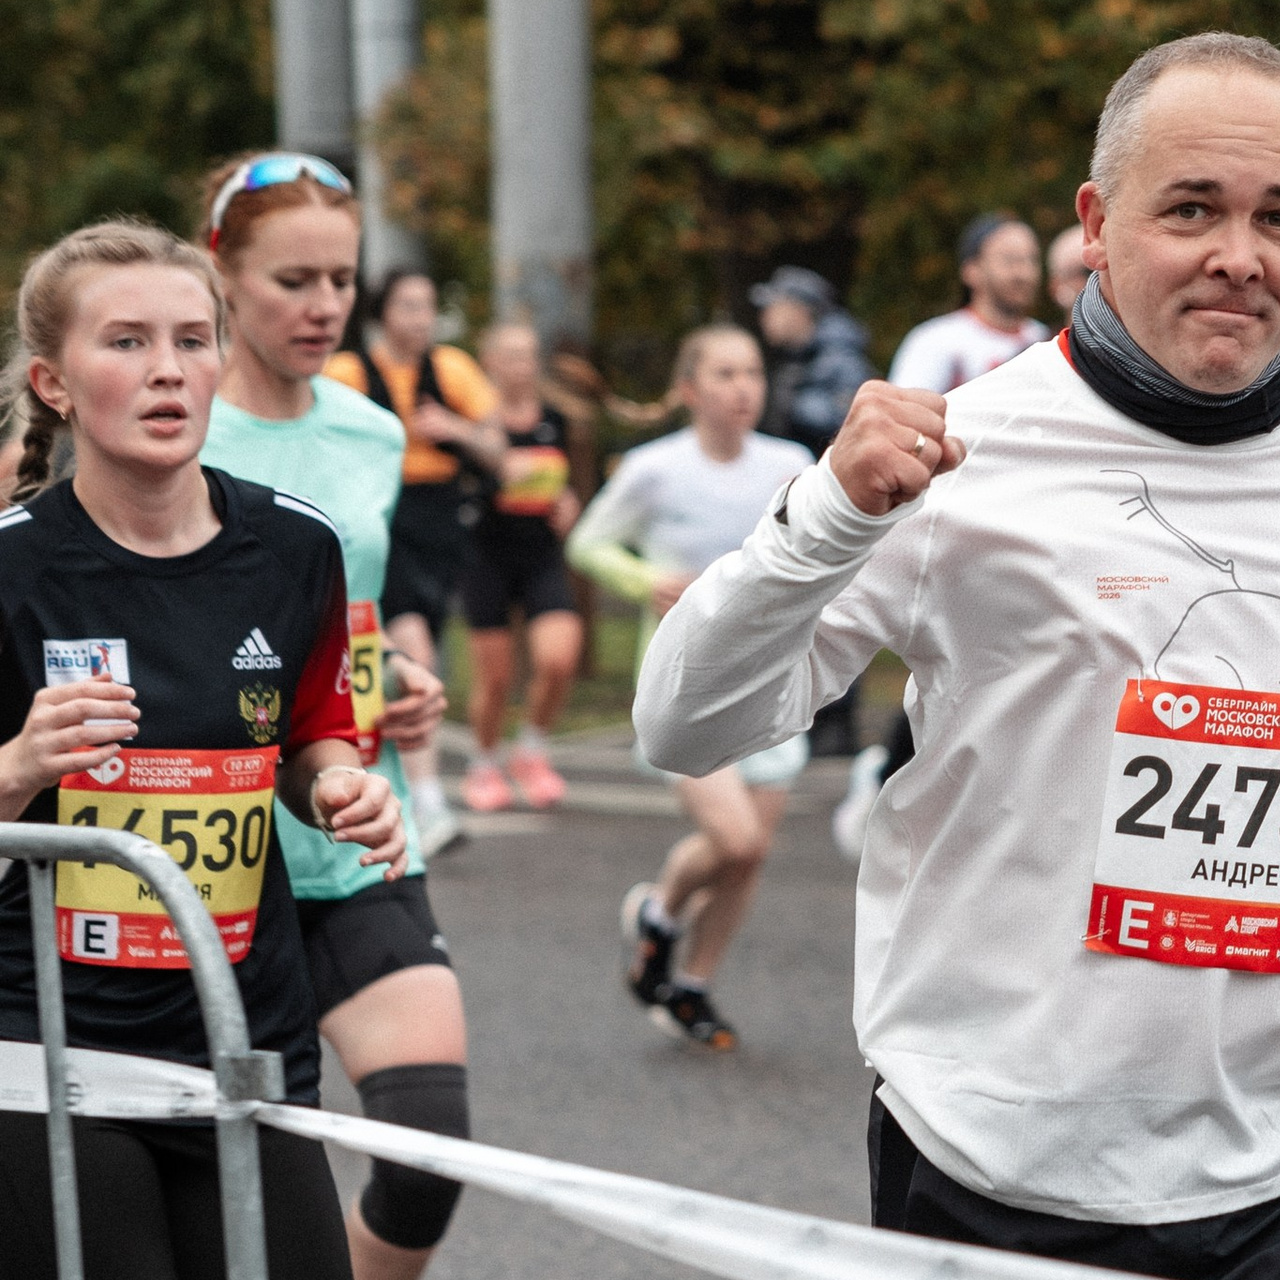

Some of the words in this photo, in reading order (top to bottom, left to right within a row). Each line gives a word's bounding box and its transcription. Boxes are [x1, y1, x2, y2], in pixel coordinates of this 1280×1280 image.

[1096, 575, 1169, 583] МОСКОВСКИЙ
[1098, 592, 1121, 600] 2026
[47, 657, 88, 668] RBU
[232, 654, 282, 670] adidas
[354, 646, 375, 694] 5
[1208, 697, 1277, 712] СБЕРПРАЙМ
[1204, 722, 1274, 740] МАРАФОН
[130, 756, 192, 766] СБЕРПРАЙМ
[129, 765, 212, 778] МОСКОВСКИЙ
[129, 776, 191, 788] МАРАФОН
[1118, 899, 1155, 949] E
[84, 919, 107, 954] E
[1195, 945, 1217, 954] BRICS
